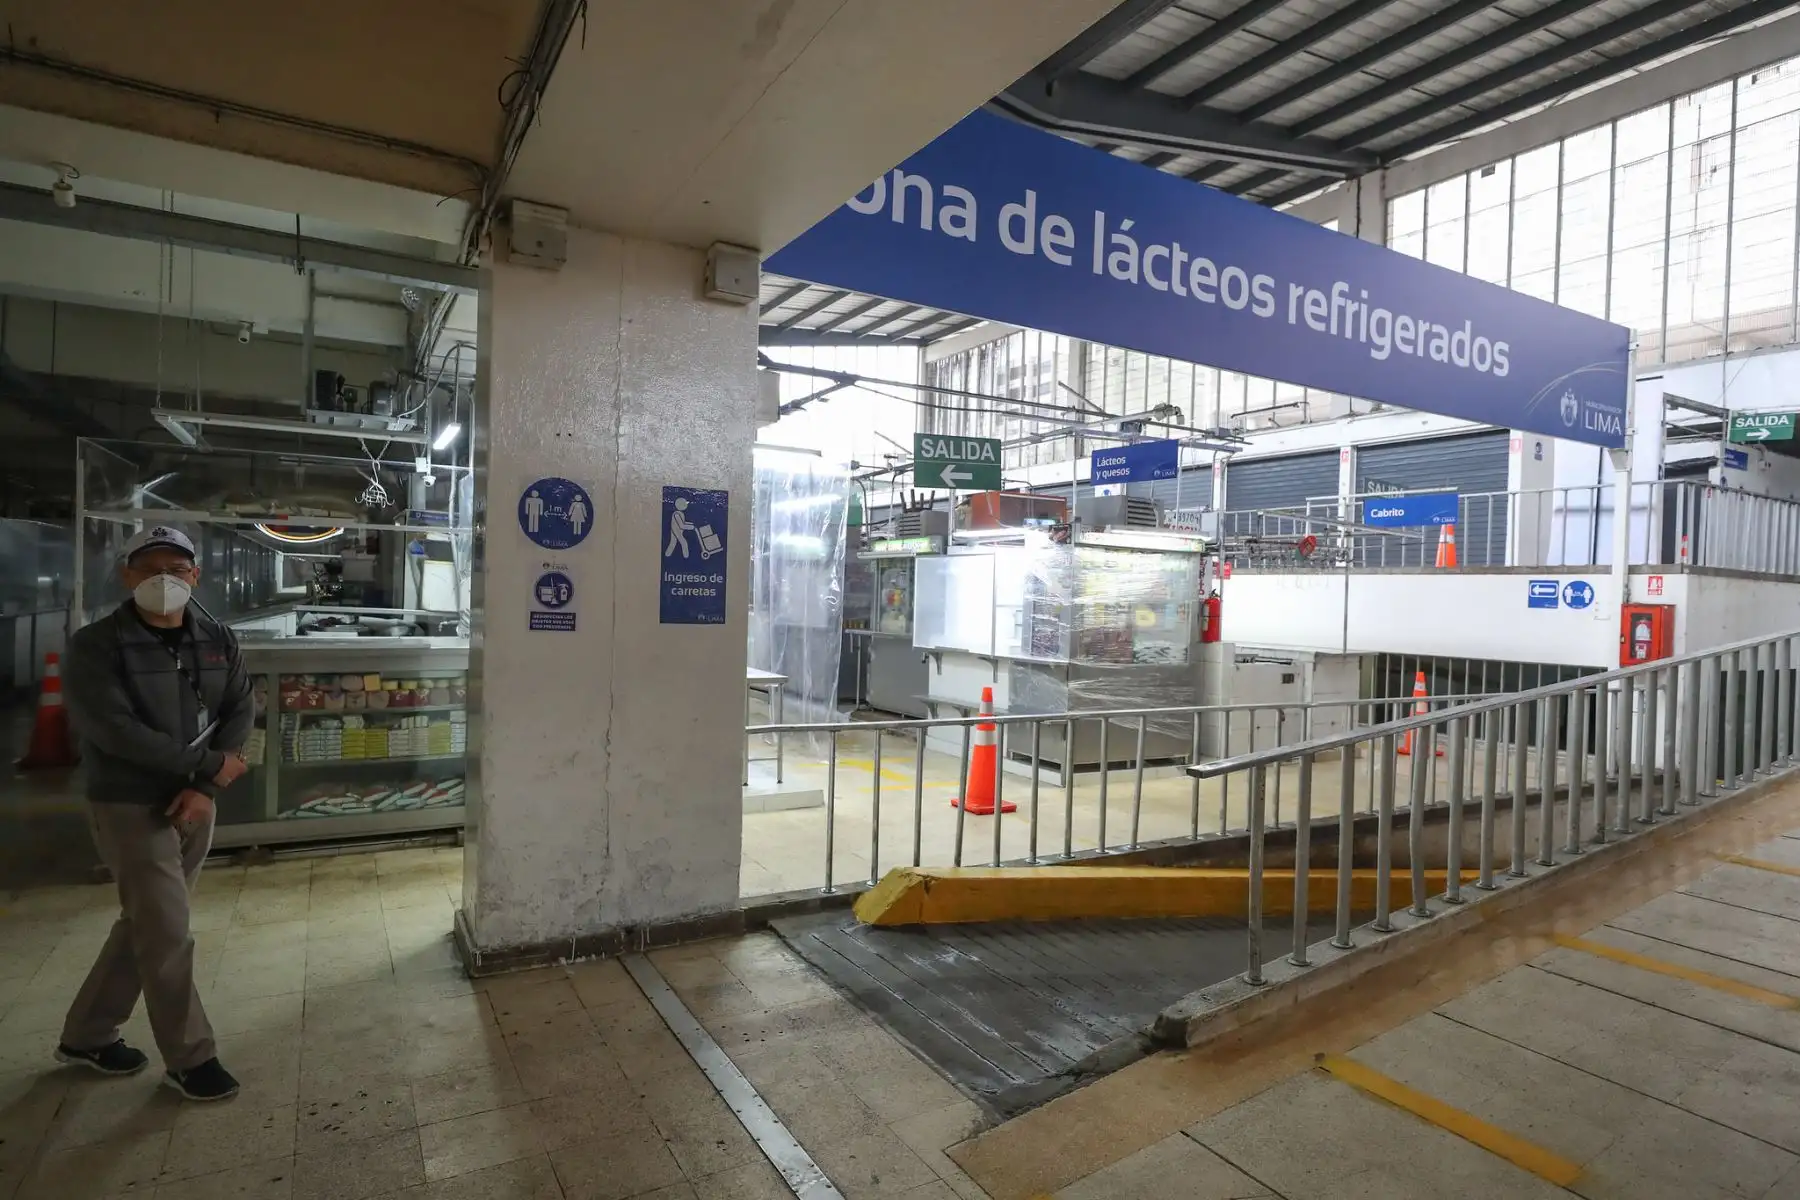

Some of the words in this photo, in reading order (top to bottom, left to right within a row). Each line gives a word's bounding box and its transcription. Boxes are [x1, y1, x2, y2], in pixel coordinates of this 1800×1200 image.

[998, 189, 1075, 266] de
[1093, 210, 1275, 318] lácteos
[1288, 281, 1511, 377] refrigerados
[1585, 409, 1622, 436] LIMA
[1736, 415, 1789, 428] SALIDA
[921, 438, 995, 462] SALIDA
[1096, 456, 1127, 467] Lácteos
[1096, 471, 1101, 480] y
[1102, 468, 1130, 478] quesos
[1370, 507, 1405, 518] Cabrito
[664, 571, 707, 585] Ingreso
[709, 573, 723, 583] de
[671, 587, 716, 597] carretas
